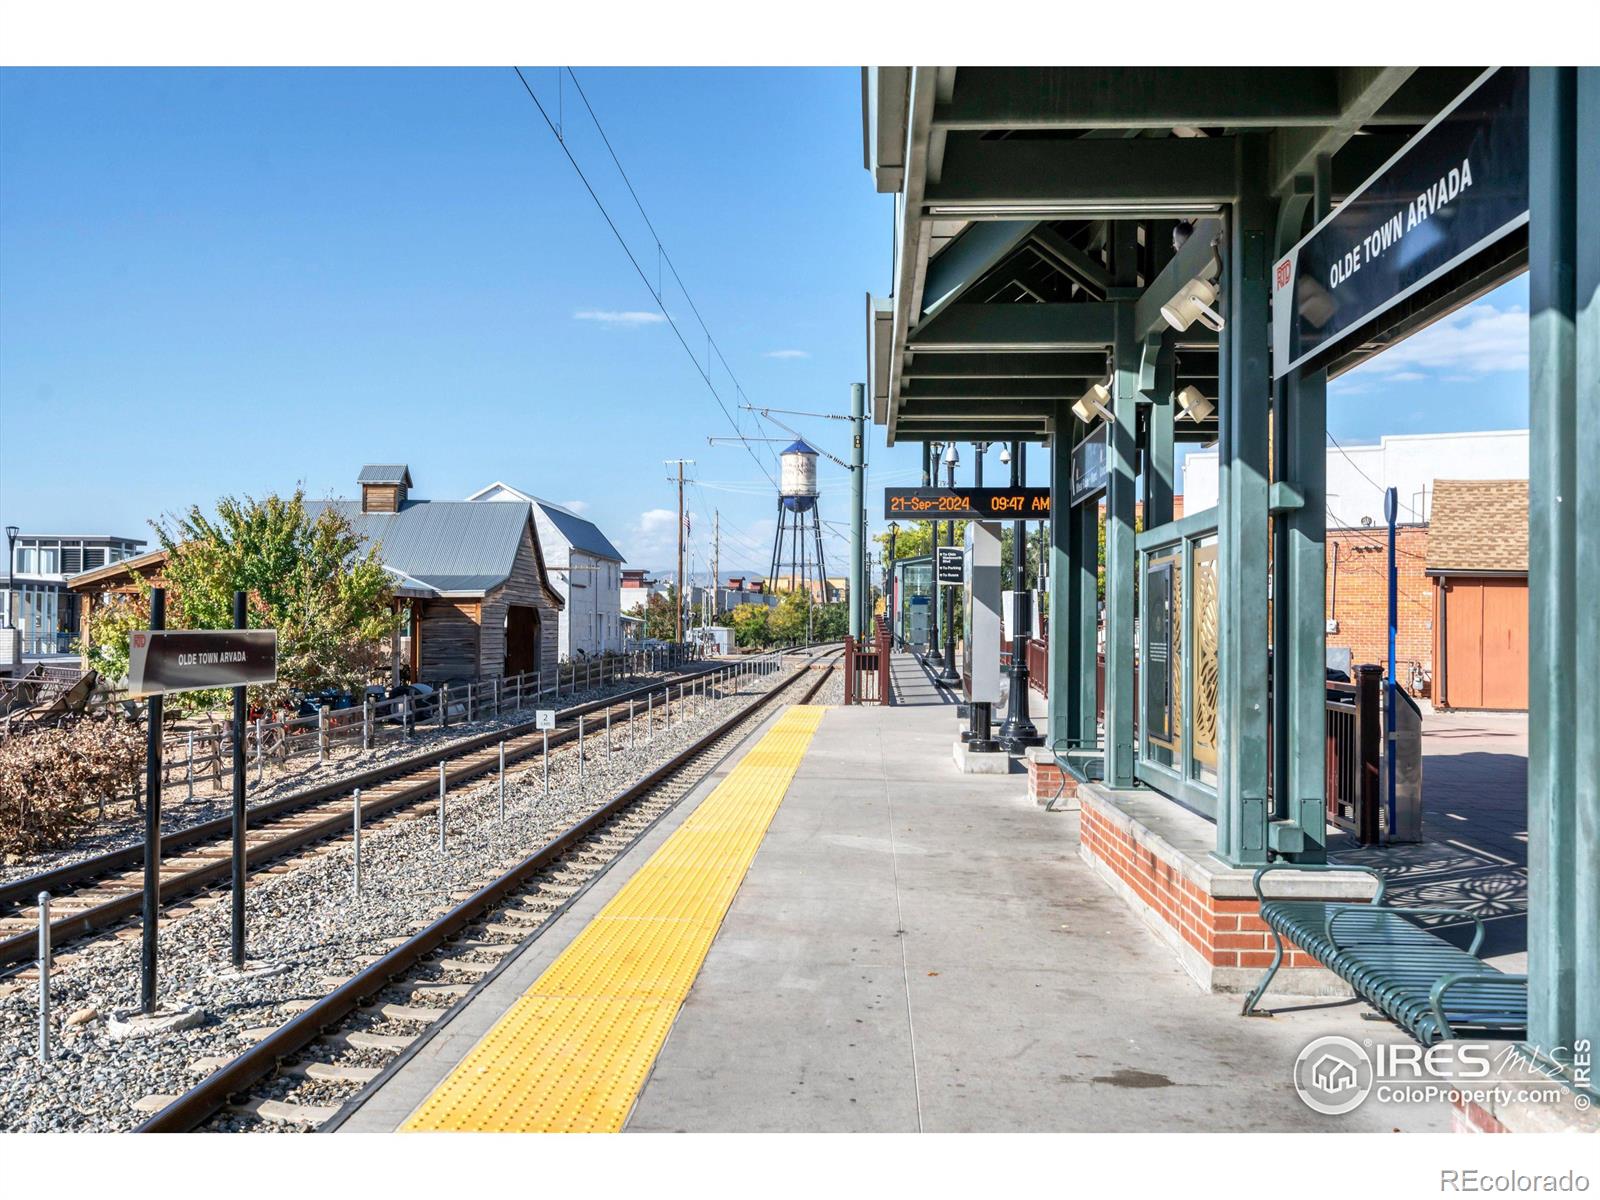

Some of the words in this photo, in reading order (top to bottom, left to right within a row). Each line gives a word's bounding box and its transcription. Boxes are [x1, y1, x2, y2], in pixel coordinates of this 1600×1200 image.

[1330, 245, 1361, 289] OLDE
[1363, 211, 1403, 263] TOWN
[1407, 158, 1473, 232] ARVADA
[1276, 259, 1291, 291] RTD
[891, 497, 970, 511] 21-Sep-2024
[991, 497, 1025, 511] 09:47
[1031, 497, 1050, 511] AM
[178, 653, 197, 666] OLDE
[198, 652, 218, 664] TOWN
[220, 651, 246, 663] ARVADA
[543, 713, 548, 721] 2
